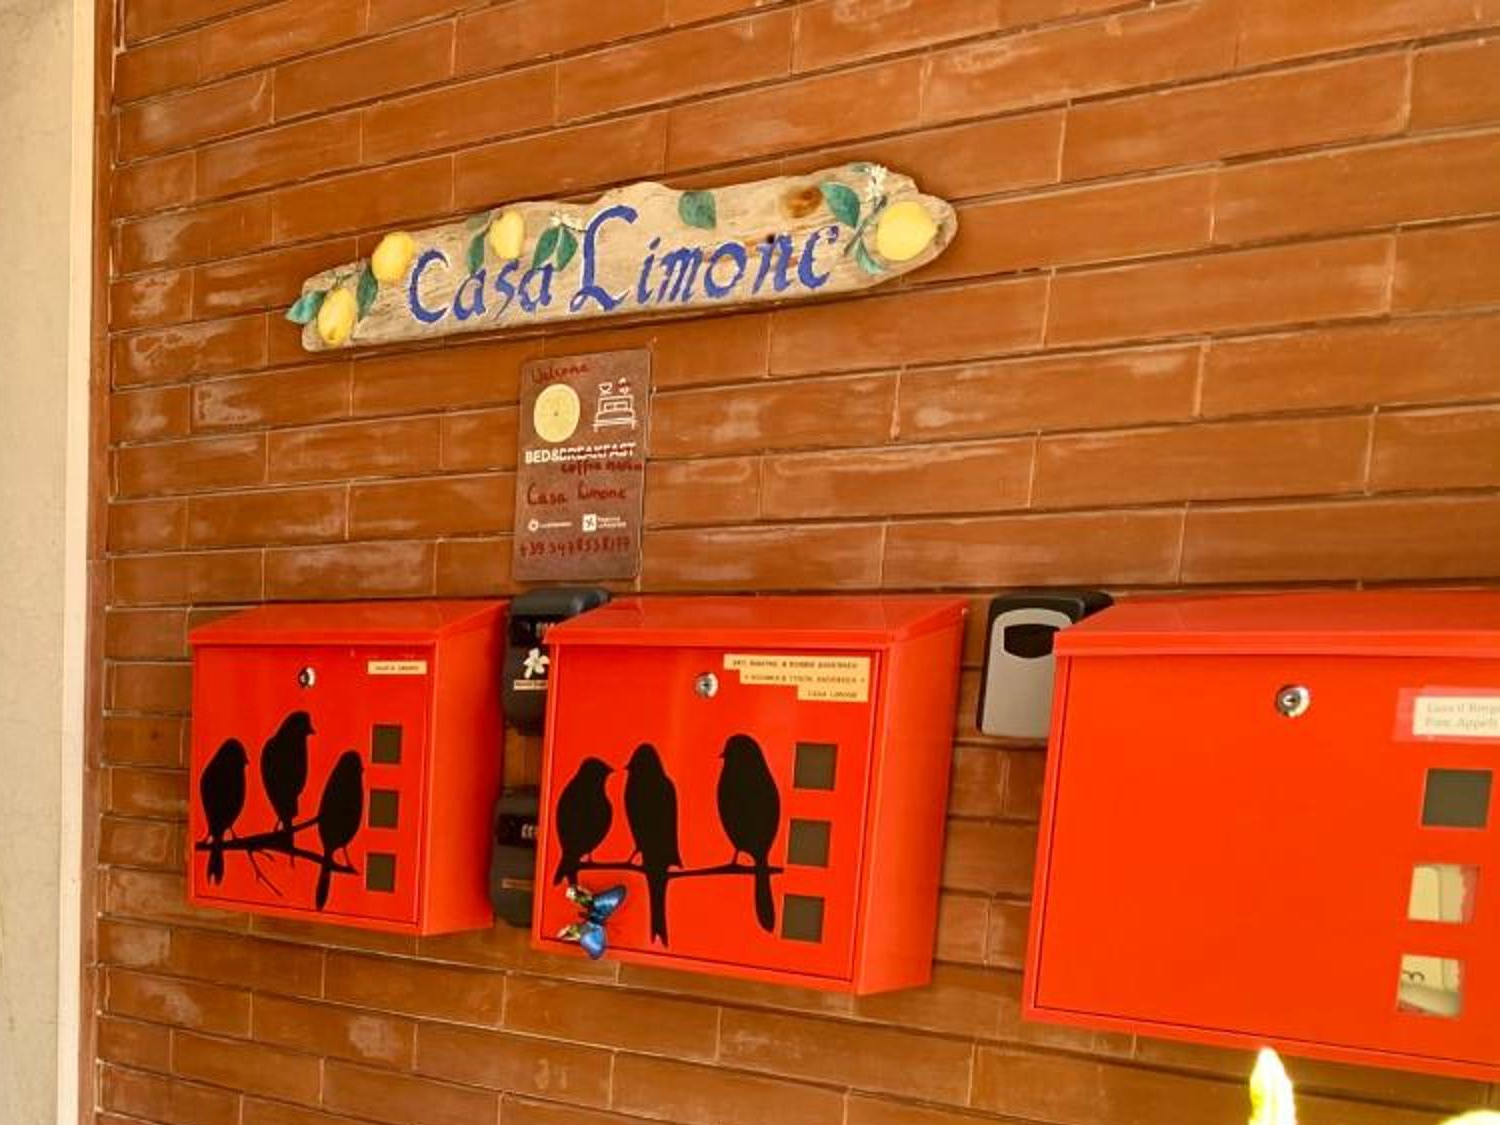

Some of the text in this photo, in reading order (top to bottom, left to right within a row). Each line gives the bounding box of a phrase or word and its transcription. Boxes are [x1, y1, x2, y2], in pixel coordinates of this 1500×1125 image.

[407, 204, 841, 324] Casa Limone
[527, 483, 627, 506] Casa Limone
